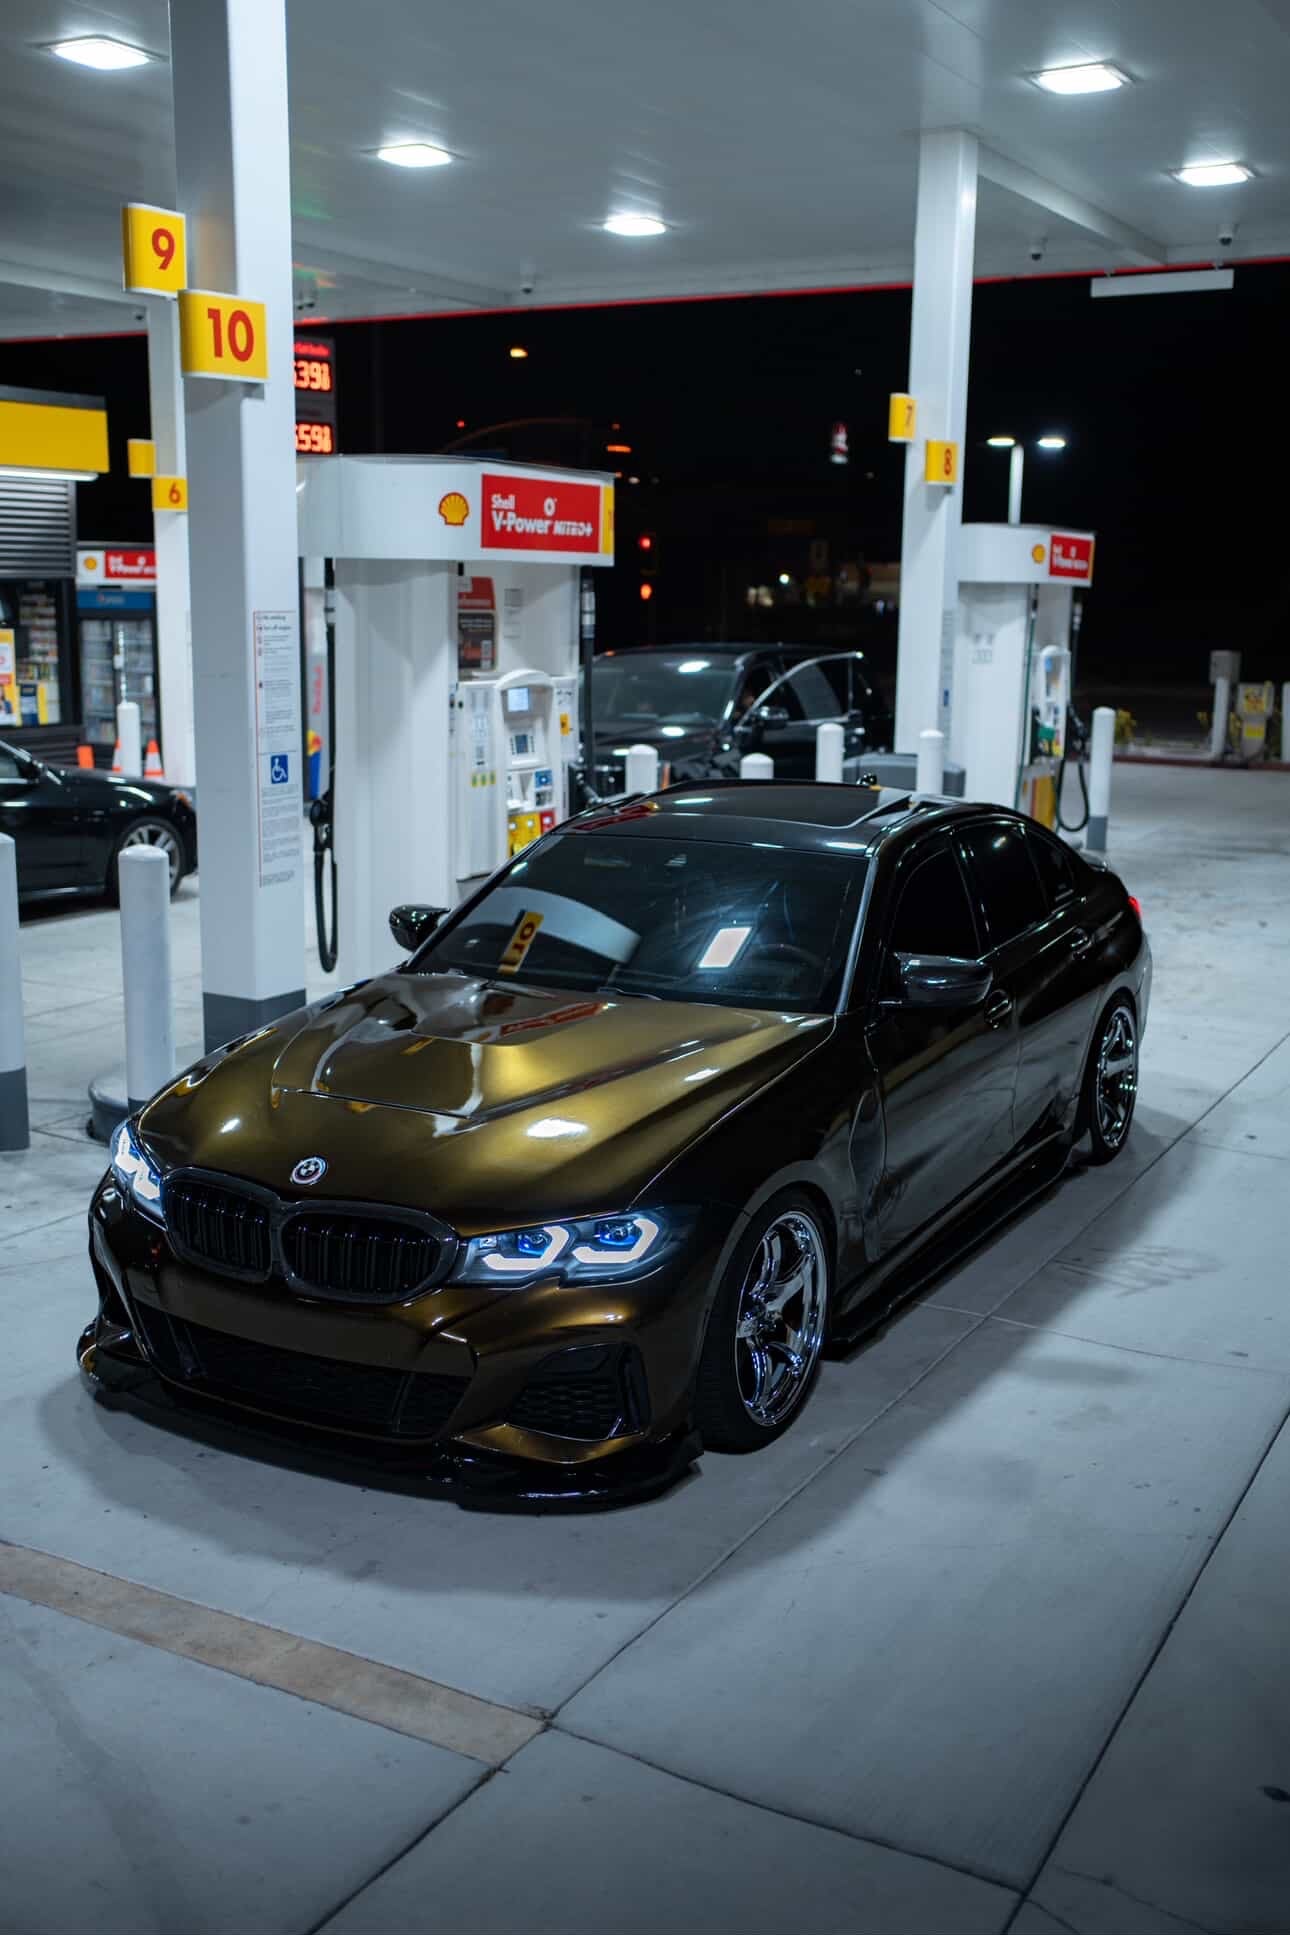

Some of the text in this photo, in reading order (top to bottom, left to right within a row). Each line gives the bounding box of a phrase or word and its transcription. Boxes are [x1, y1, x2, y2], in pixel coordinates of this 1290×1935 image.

[152, 228, 176, 271] 9
[207, 307, 255, 362] 10
[943, 447, 953, 476] 8
[168, 482, 181, 504] 6
[491, 511, 549, 535] V-Power
